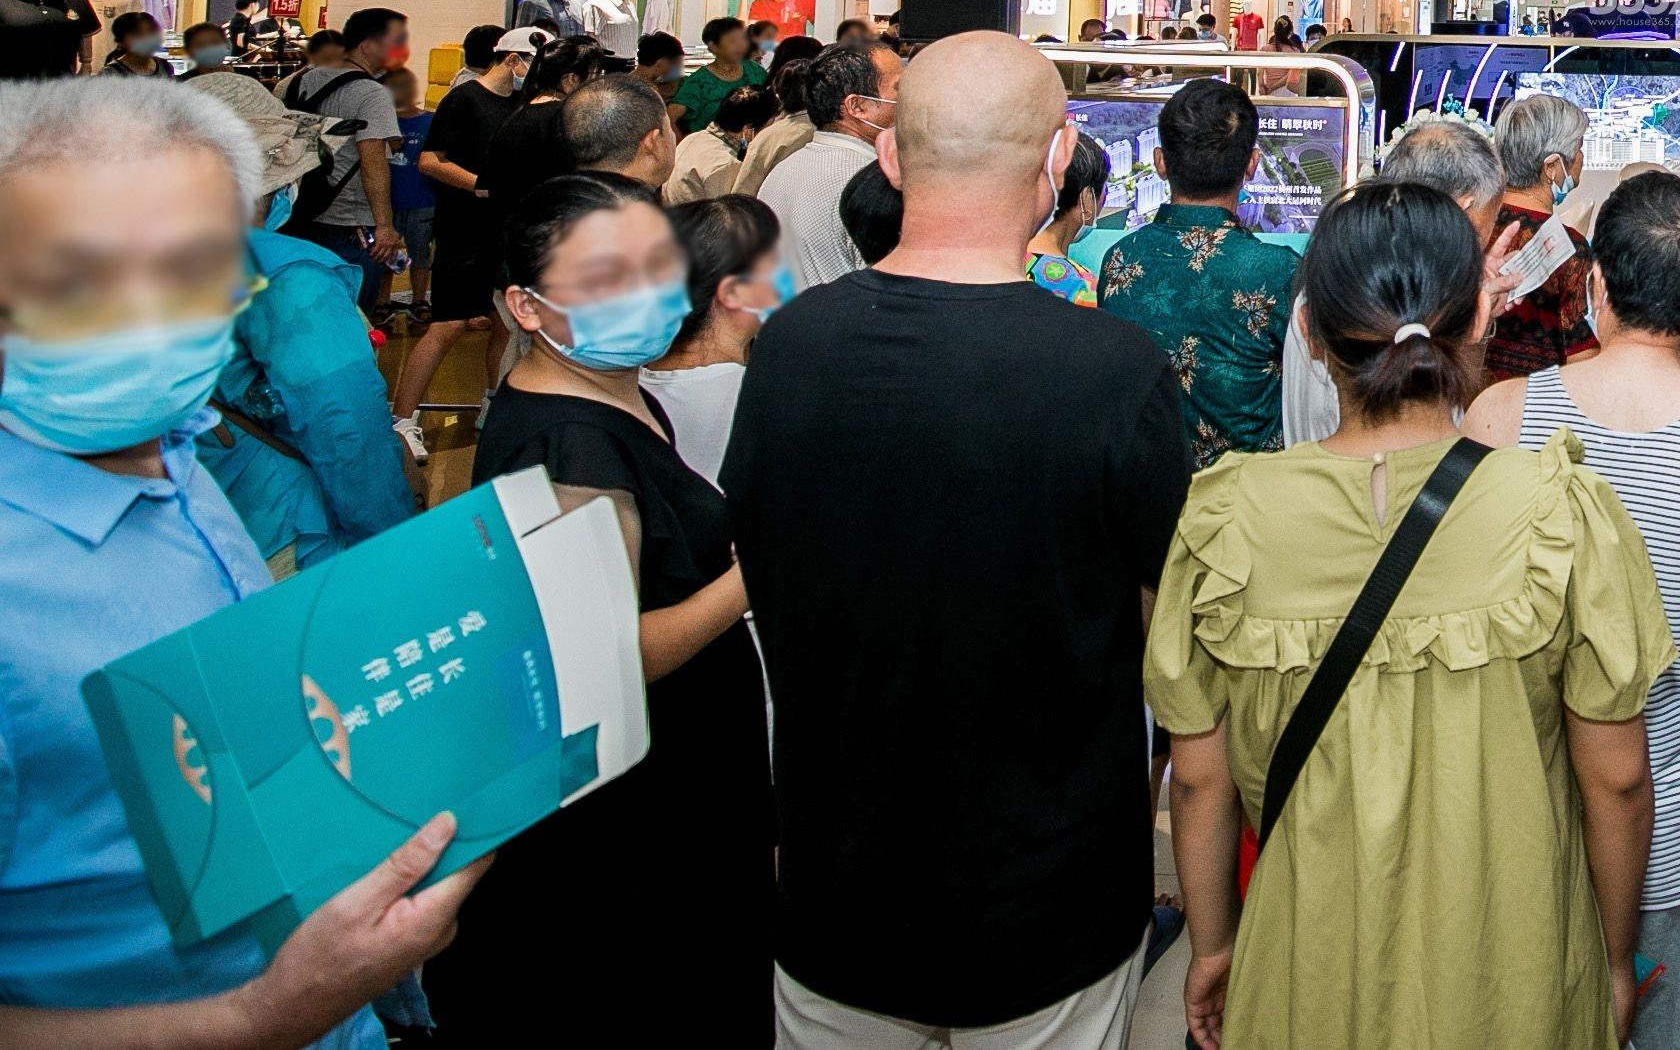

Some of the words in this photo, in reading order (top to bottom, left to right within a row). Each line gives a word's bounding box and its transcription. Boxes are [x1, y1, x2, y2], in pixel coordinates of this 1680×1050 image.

[361, 608, 488, 683] 爱是陪伴
[340, 658, 468, 734] 长住是家
